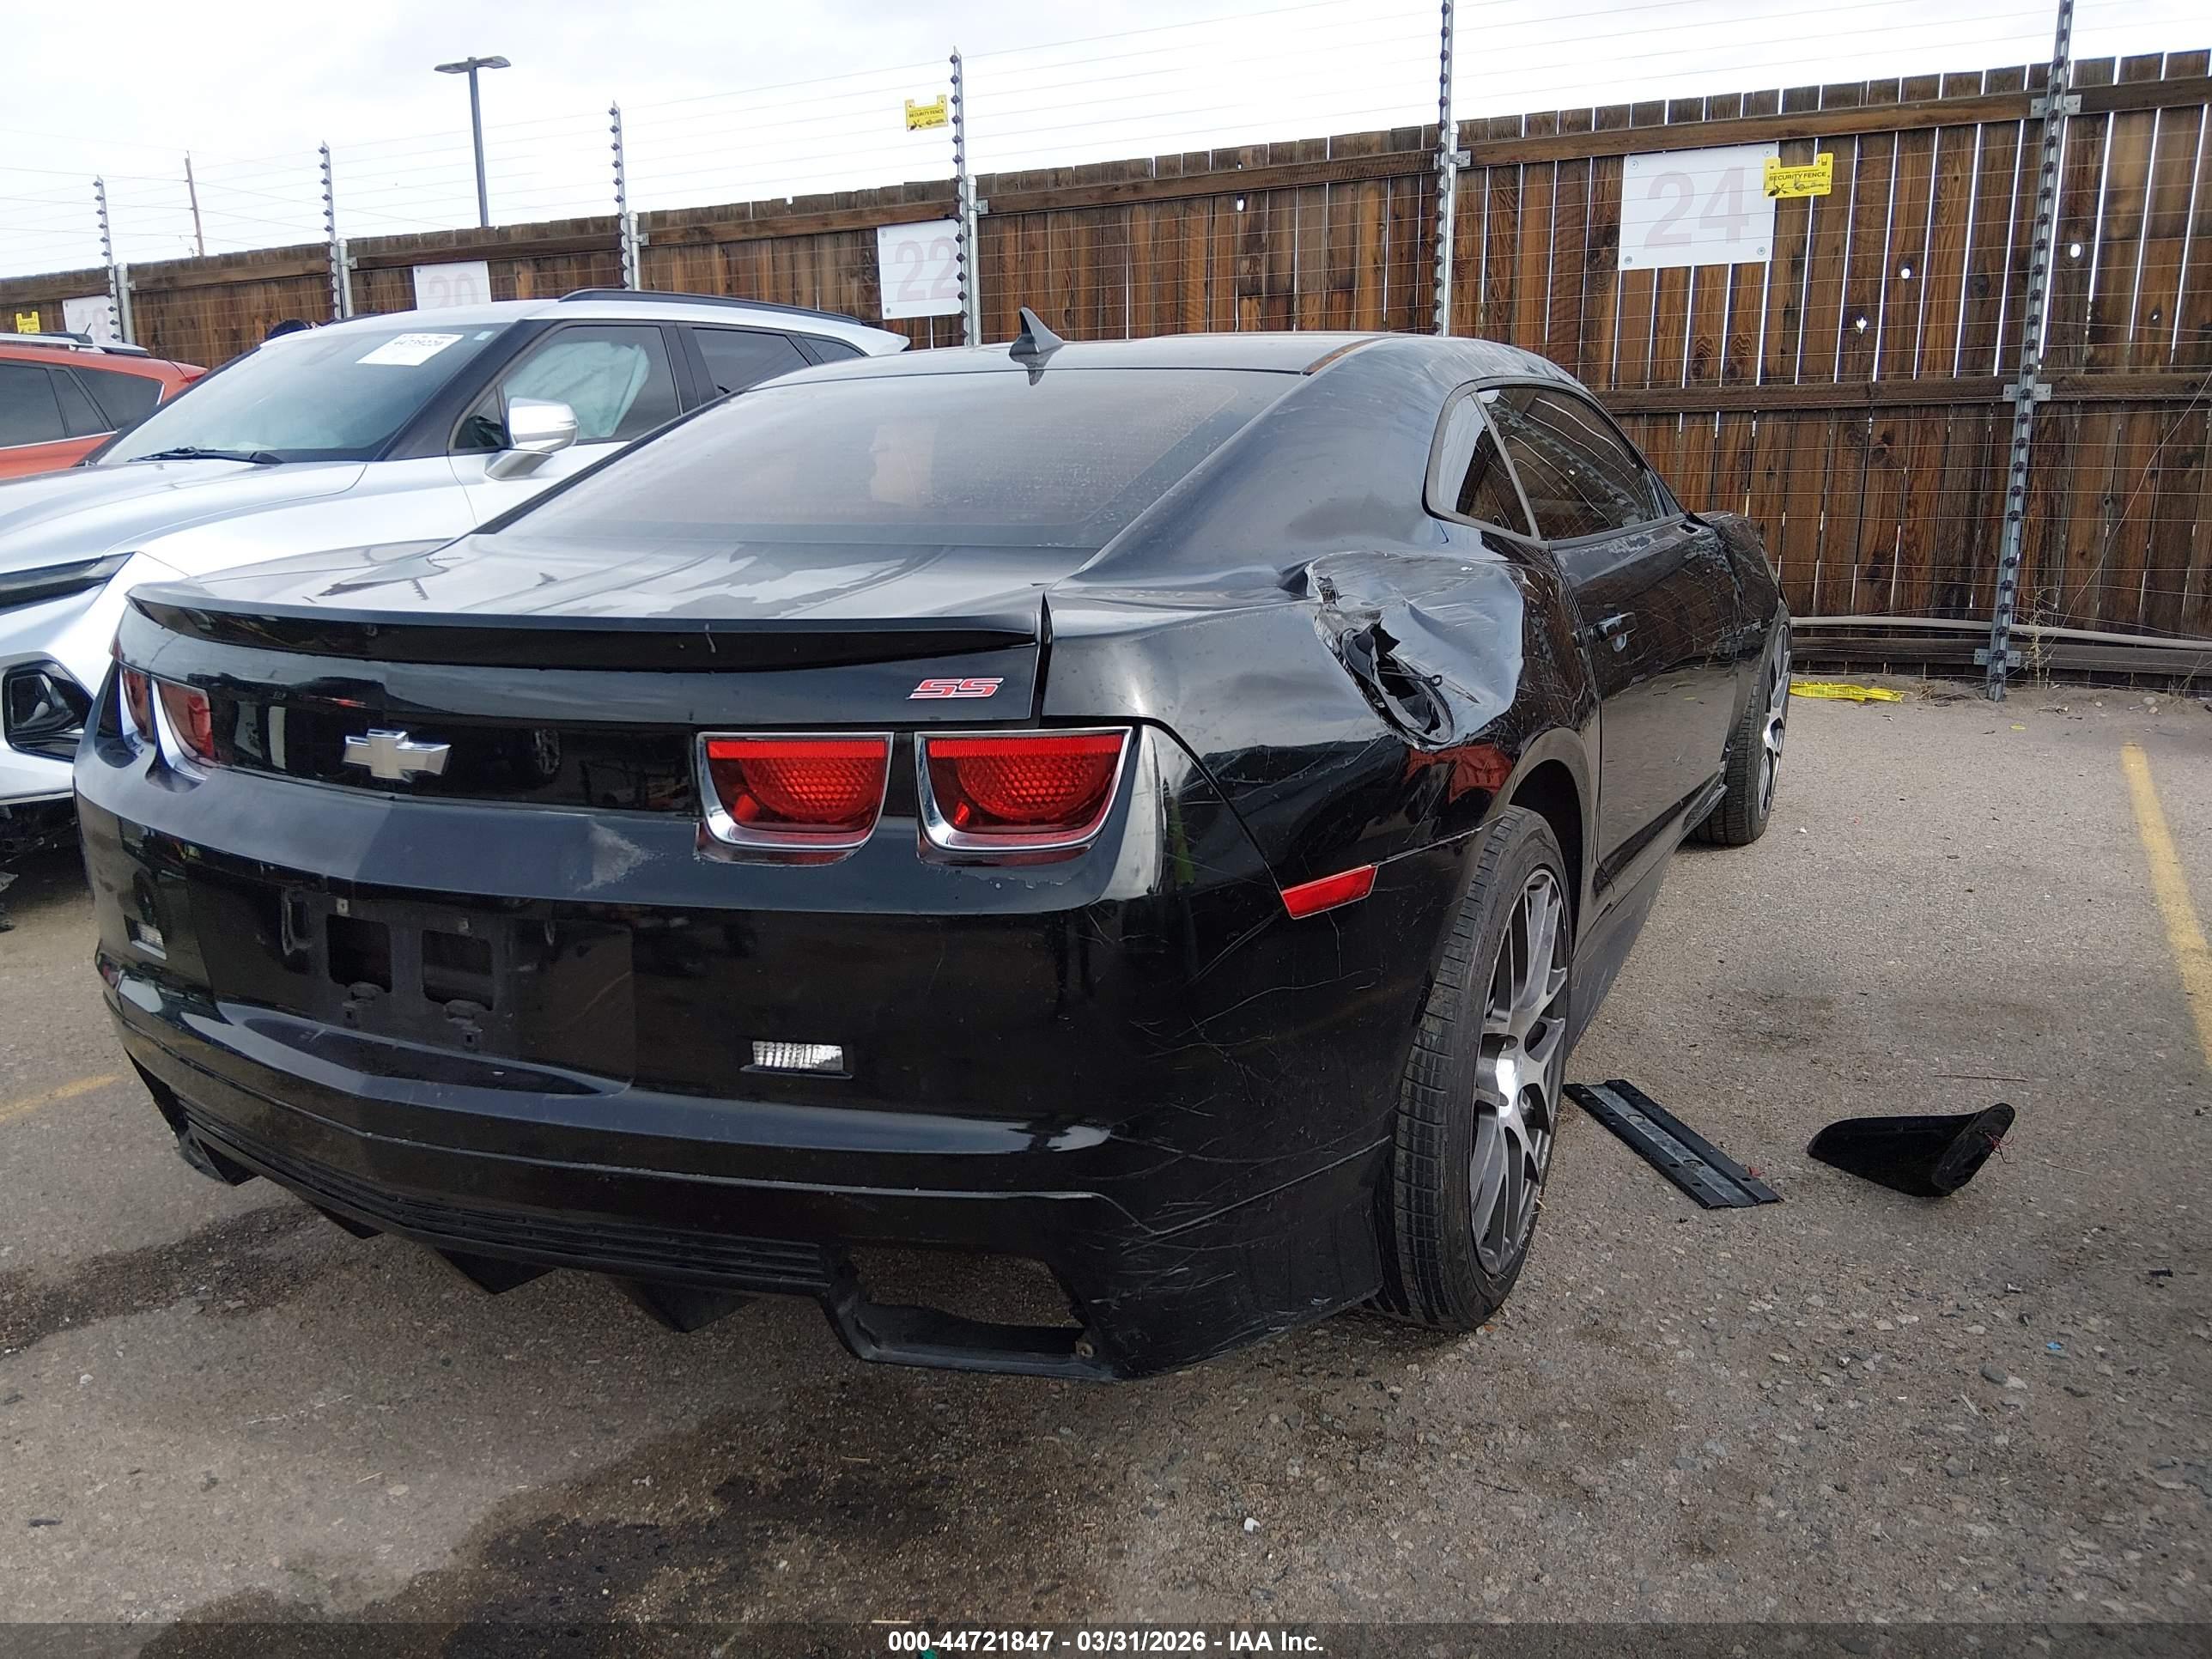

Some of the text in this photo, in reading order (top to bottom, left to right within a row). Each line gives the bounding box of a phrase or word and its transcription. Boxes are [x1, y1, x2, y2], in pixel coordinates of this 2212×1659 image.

[1769, 173, 1803, 181] SECURITY
[1644, 167, 1750, 250] 24
[895, 236, 959, 302] 22
[428, 272, 479, 307] 20
[907, 677, 1004, 700] SS
